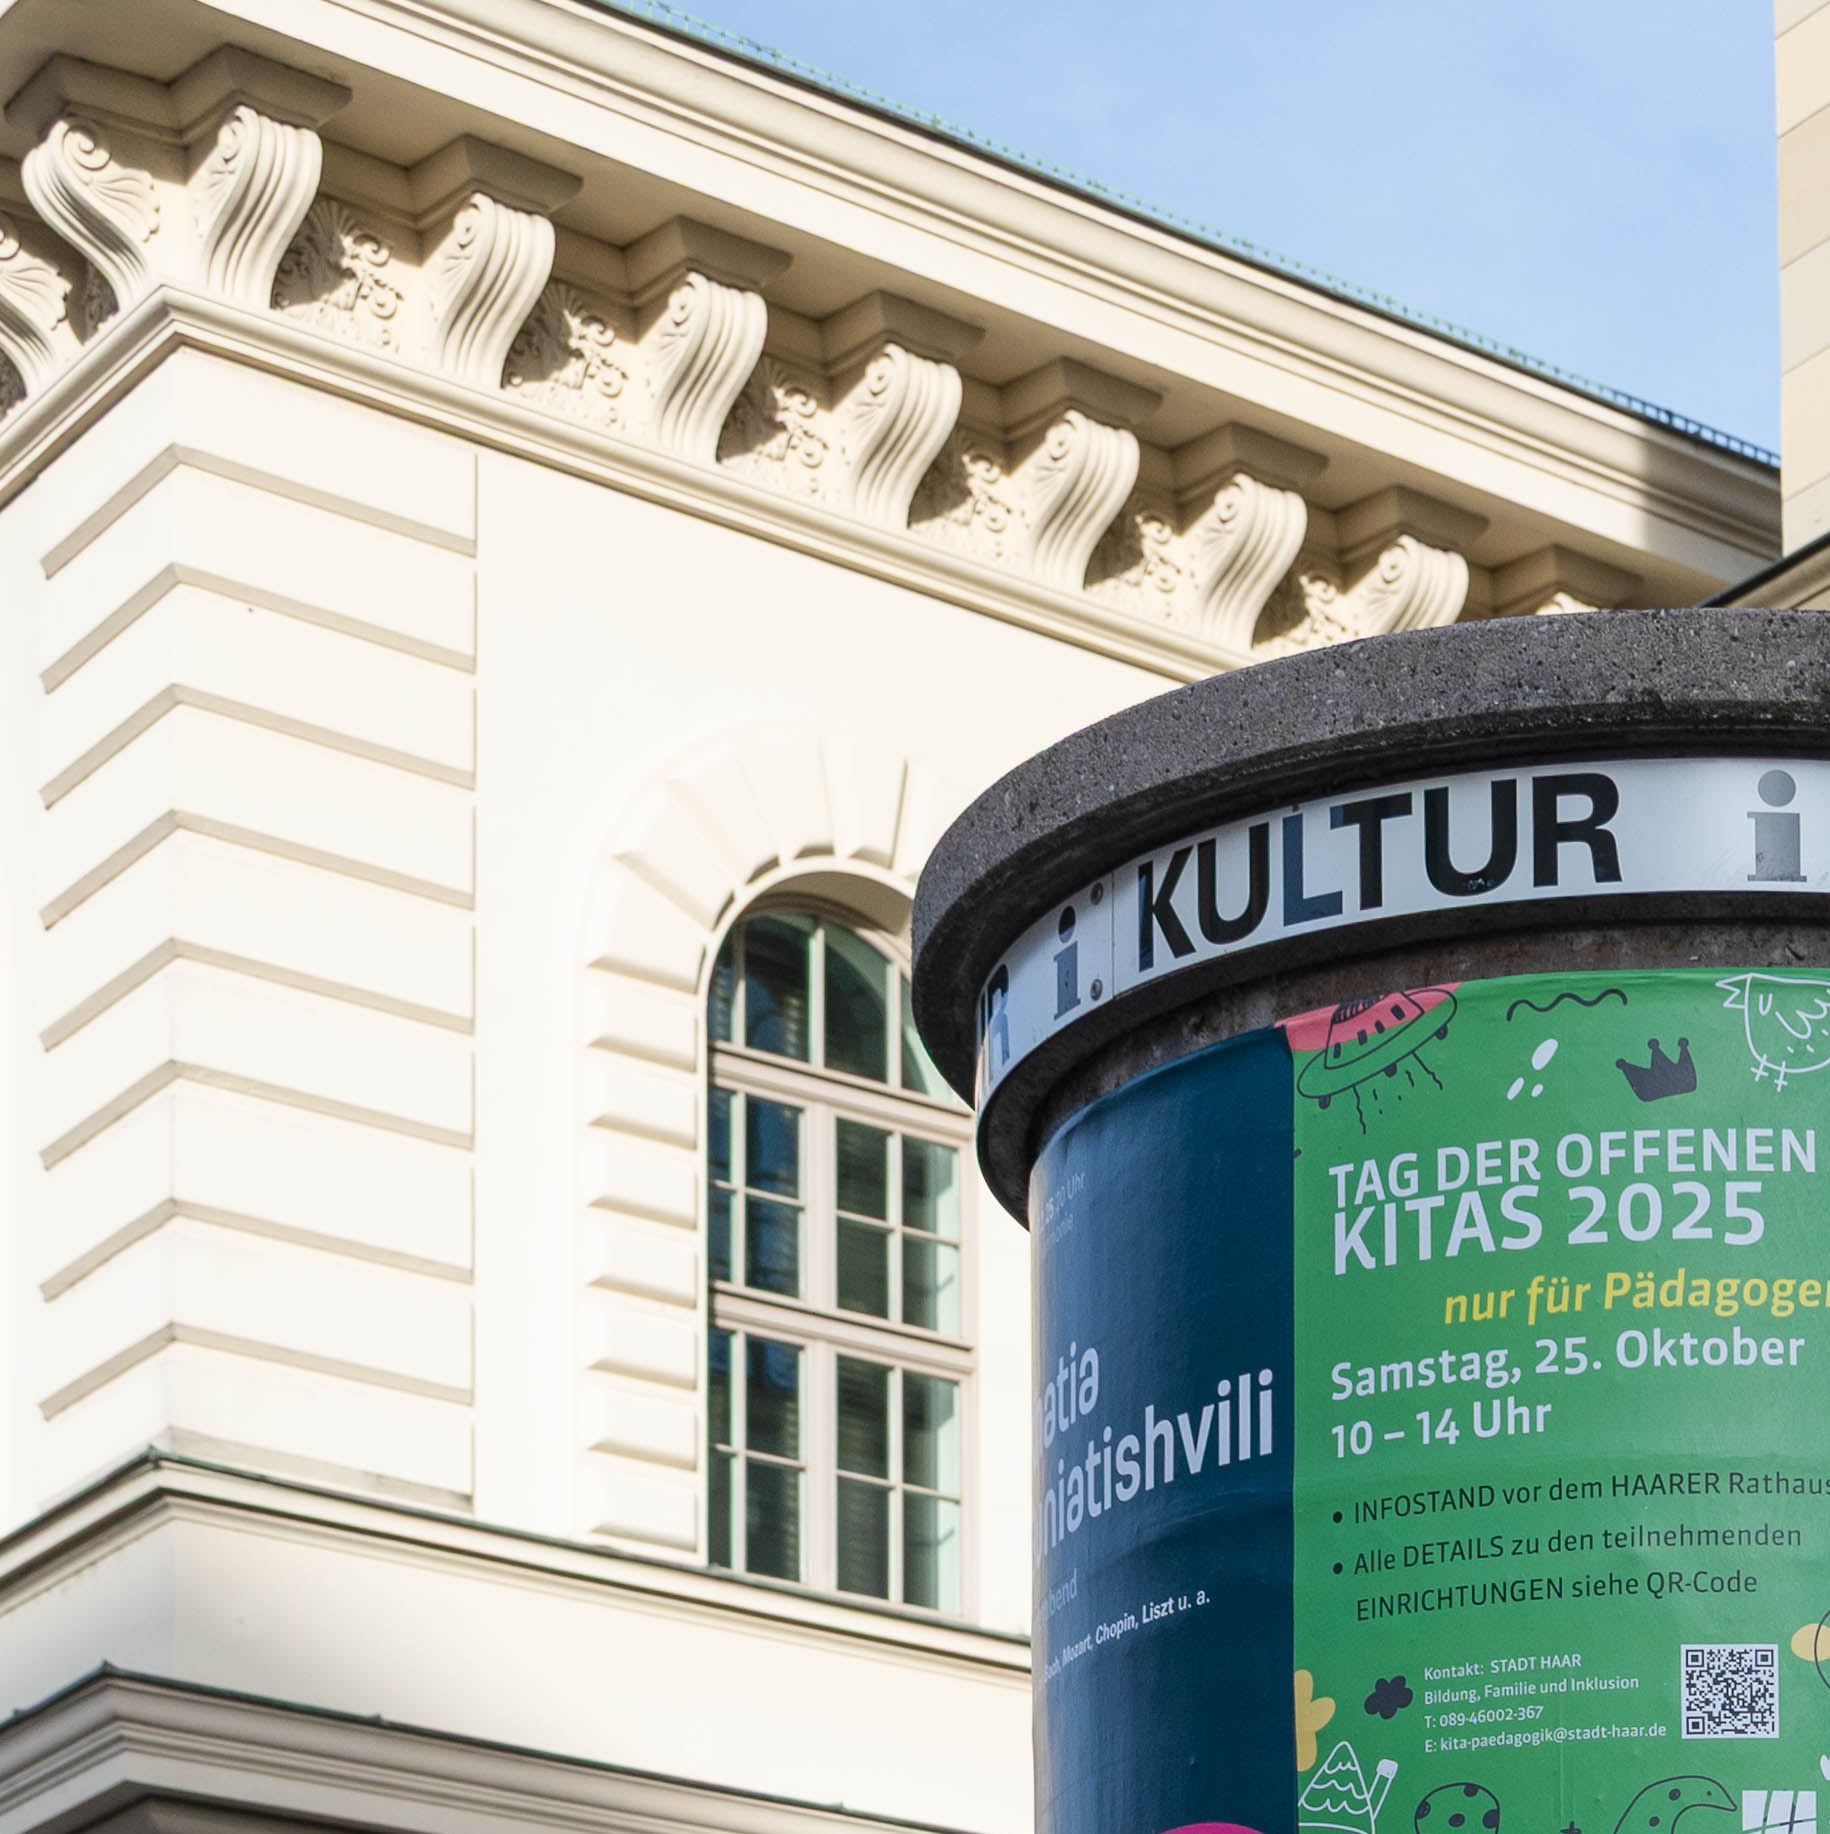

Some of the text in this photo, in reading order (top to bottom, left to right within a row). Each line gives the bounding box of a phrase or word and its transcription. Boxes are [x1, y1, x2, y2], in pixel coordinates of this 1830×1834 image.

[1138, 771, 1620, 973] KULTUR
[1329, 1128, 1816, 1208] TAG DER OFFENEN
[1333, 1181, 1764, 1275] KITAS 2025
[1445, 1287, 1514, 1323] nur
[1528, 1275, 1590, 1324] für
[1331, 1327, 1805, 1401] Samstag, 25. Oktober
[1331, 1397, 1551, 1458] 10 14 Uhr
[1354, 1485, 1494, 1524] INFOSTAND
[1503, 1482, 1542, 1505] vor
[1549, 1477, 1602, 1502] dem
[1611, 1473, 1720, 1497] HAARER
[1095, 1612, 1139, 1645] Chopin,
[1142, 1596, 1174, 1625] Liszt
[1424, 1654, 1581, 1681] Kontakt: STADT HAAR
[1424, 1722, 1667, 1753] E: kita-paedagogik@stadt-haar.de
